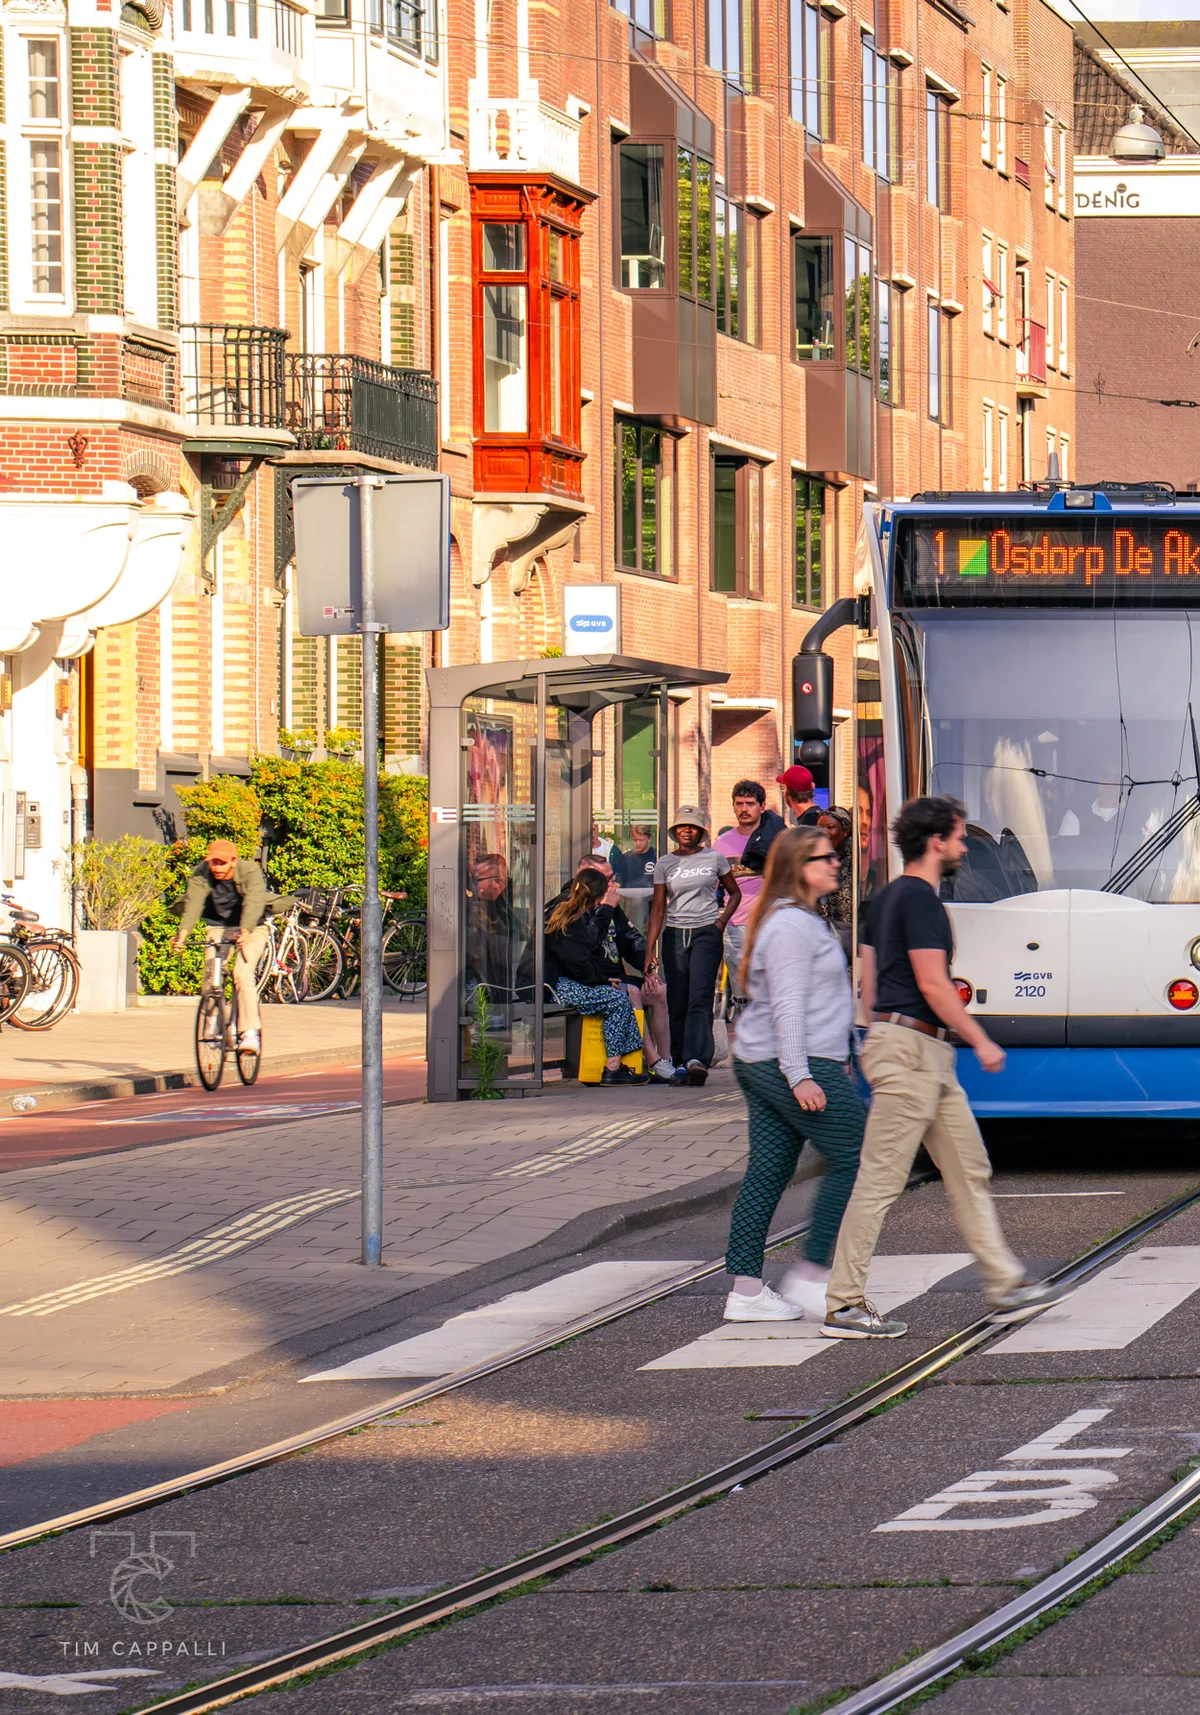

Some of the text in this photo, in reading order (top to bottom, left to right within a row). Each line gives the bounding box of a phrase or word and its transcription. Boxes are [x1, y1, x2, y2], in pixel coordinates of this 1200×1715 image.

[936, 531, 944, 575] 1
[990, 530, 1104, 585] Osdorp
[1115, 530, 1153, 575] De
[1032, 972, 1053, 980] GVB
[1014, 985, 1046, 998] 2120
